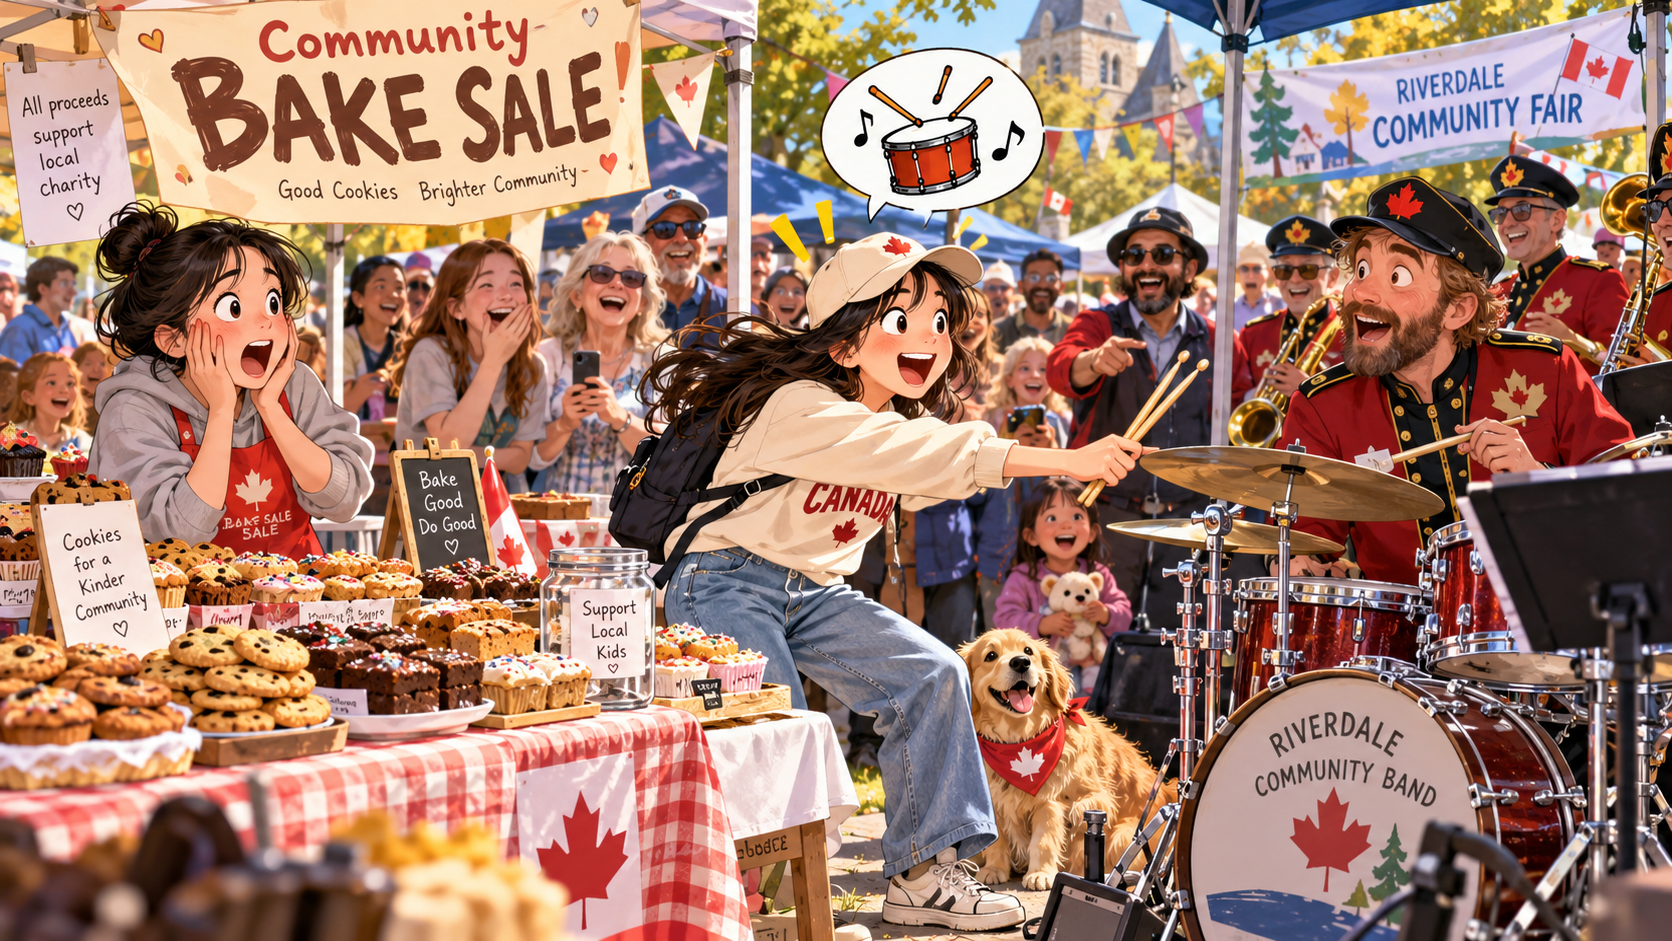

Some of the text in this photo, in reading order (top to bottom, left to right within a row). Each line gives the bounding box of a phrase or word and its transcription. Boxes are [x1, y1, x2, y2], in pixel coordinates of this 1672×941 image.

[258, 10, 529, 67] Community
[1396, 62, 1505, 105] RIVERDALE
[22, 88, 110, 120] All proceeds
[170, 51, 612, 173] BAKE SALE
[1372, 93, 1583, 149] COMMUNITY FAIR
[33, 119, 94, 148] support
[39, 147, 80, 171] local
[39, 172, 101, 197] charity
[278, 163, 578, 207] Good Cookies Brighter Community
[418, 469, 458, 490] Bake
[424, 490, 464, 512] Good
[803, 482, 894, 526] CANADA
[264, 510, 292, 524] SALE
[418, 513, 477, 535] Do Good
[63, 528, 122, 551] Cookies
[242, 524, 279, 541] SALE
[73, 555, 112, 573] for a
[78, 573, 125, 596] Kinder
[75, 591, 148, 621] Community
[582, 600, 637, 622] Support
[591, 621, 628, 639] Local
[596, 643, 627, 660] Kids
[1268, 711, 1405, 758] RIVERDALE
[1255, 758, 1437, 807] COMMUNITY BAND
